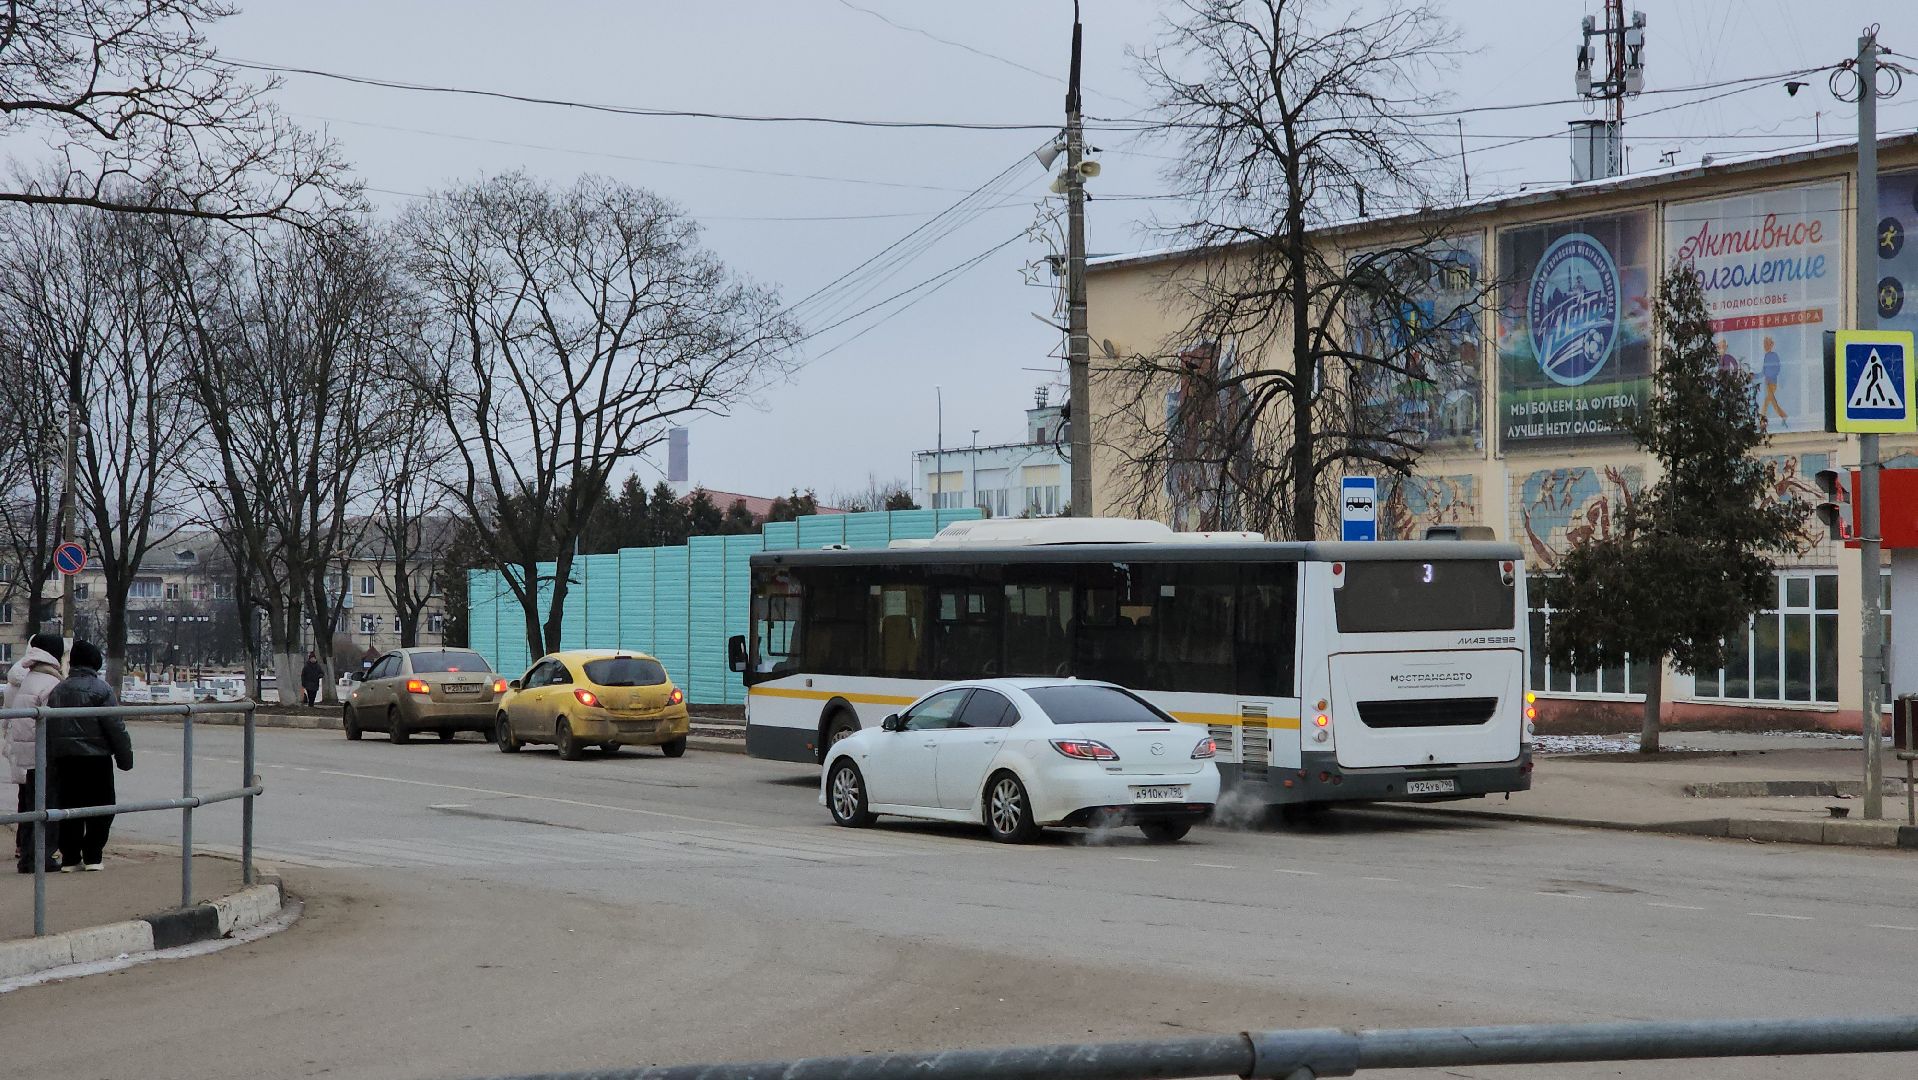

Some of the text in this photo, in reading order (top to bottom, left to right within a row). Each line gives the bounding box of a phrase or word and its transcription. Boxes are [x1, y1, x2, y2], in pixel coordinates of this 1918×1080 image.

[1678, 213, 1823, 259] Активное
[1721, 293, 1788, 309] ПОДМОСКОВЬЕ
[1736, 312, 1820, 327] ГУБЕРНАТОРА
[1510, 404, 1528, 416] МЫ
[1531, 399, 1573, 414] БОЛЕЕМ
[1576, 399, 1589, 411] ЗА
[1507, 423, 1544, 438] ЛУЧШЕ
[1546, 421, 1571, 435] НЕТУ
[1422, 564, 1433, 583] 3
[1487, 636, 1516, 644] 5292
[1390, 672, 1473, 683] МОСТРАНСАВТО
